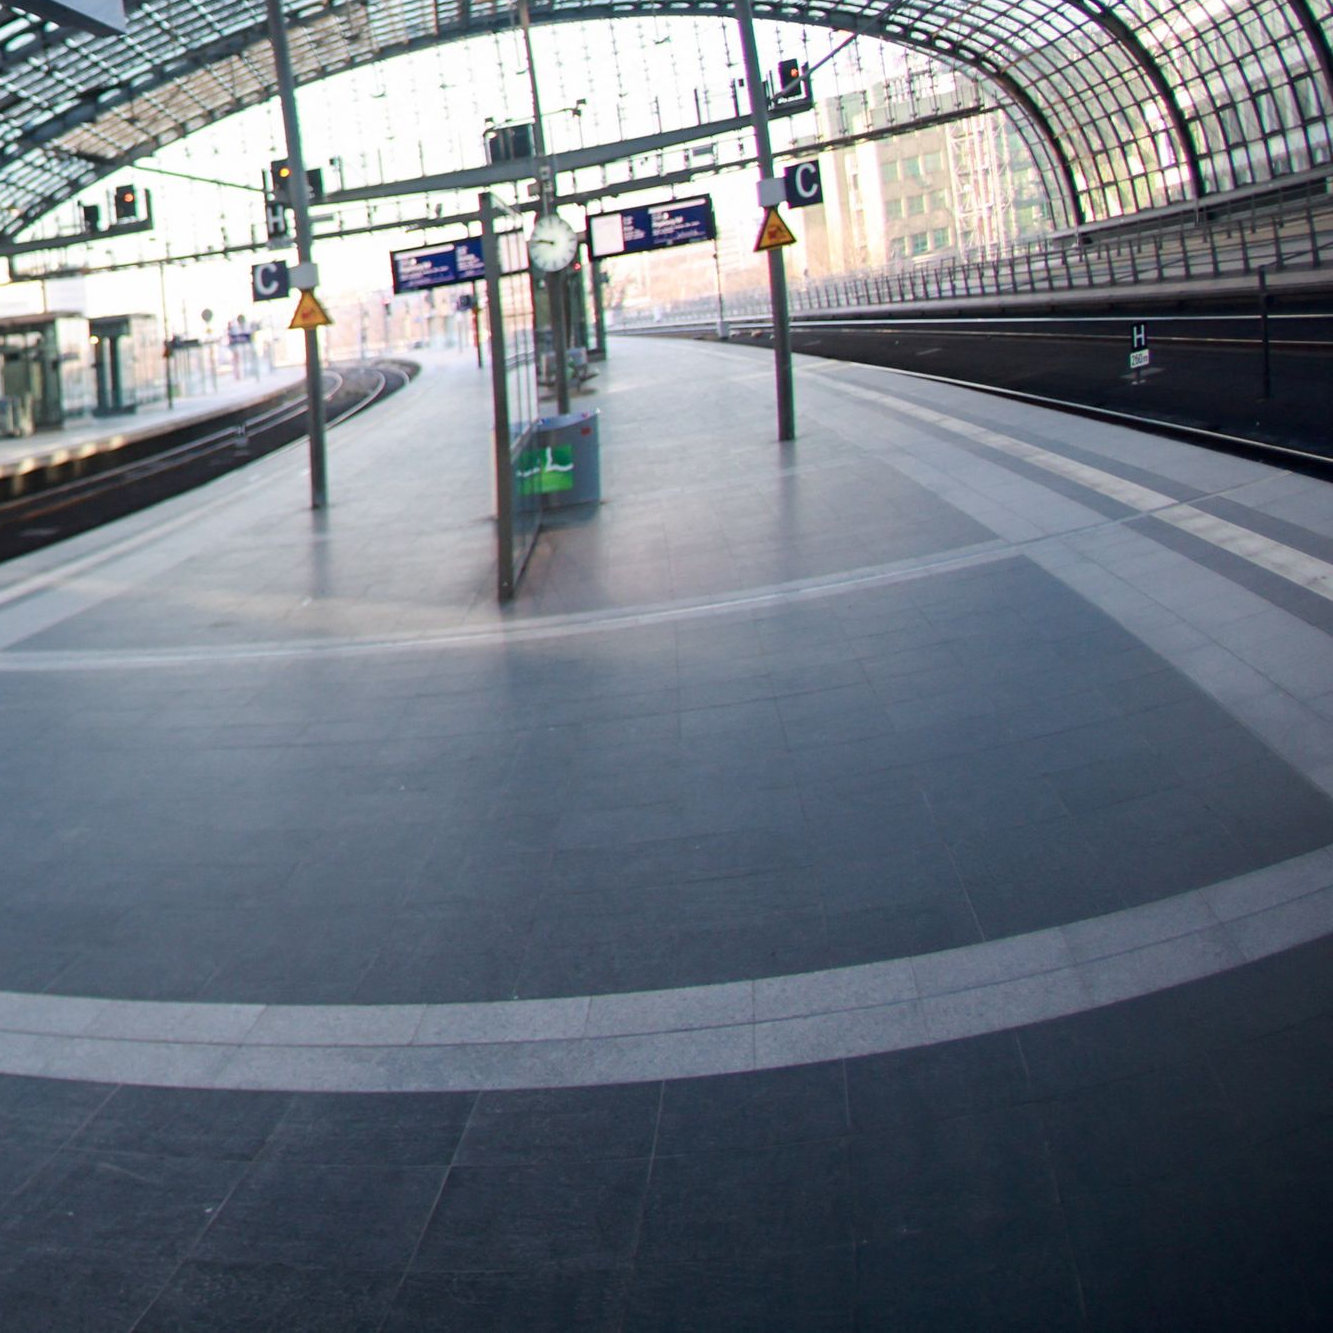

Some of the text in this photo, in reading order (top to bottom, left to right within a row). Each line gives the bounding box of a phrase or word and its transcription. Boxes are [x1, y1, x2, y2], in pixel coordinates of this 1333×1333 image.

[795, 162, 818, 198] C
[266, 204, 284, 234] H
[253, 263, 279, 296] C
[1133, 324, 1145, 348] H
